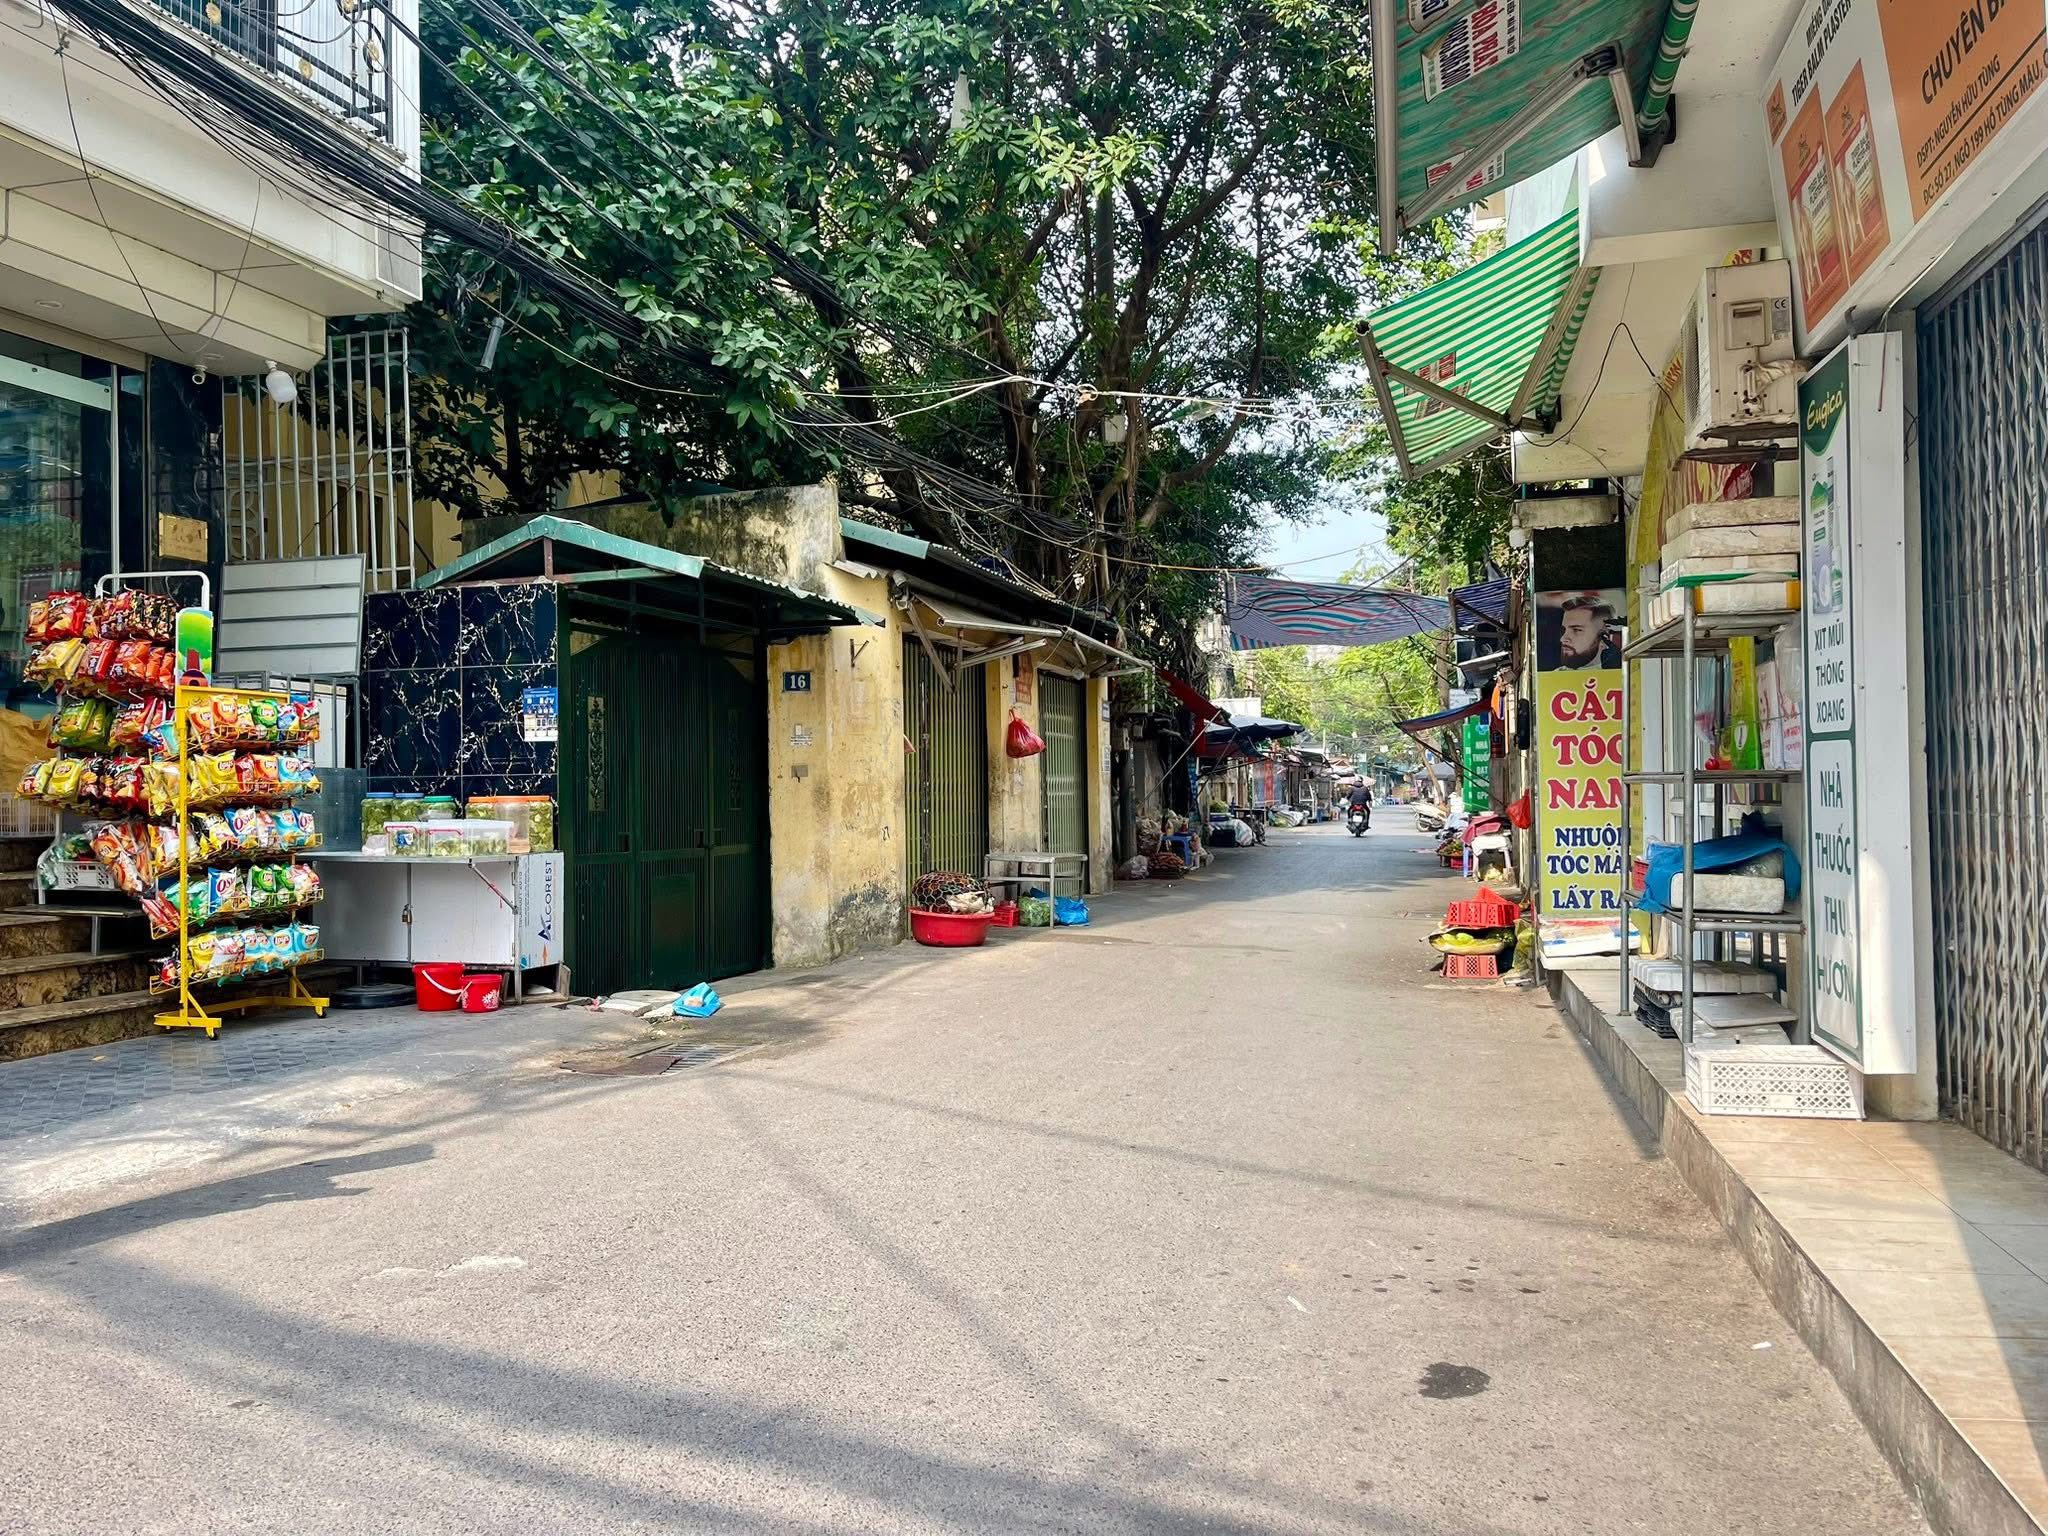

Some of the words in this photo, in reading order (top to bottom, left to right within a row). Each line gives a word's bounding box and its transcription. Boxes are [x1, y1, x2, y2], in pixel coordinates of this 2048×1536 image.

[1471, 1, 1505, 41] HÒA
[1473, 31, 1506, 72] PHÁT
[1792, 67, 1809, 107] TIGER
[1807, 36, 1825, 80] BALM
[1921, 0, 1985, 104] CHUYÊN
[1916, 137, 1936, 168] DSPT:
[1978, 54, 2000, 92] TÙNG
[1970, 125, 1984, 152] 199
[1996, 84, 2019, 122] TÙNG
[1807, 389, 1843, 430] Eugica
[1814, 628, 1827, 656] XỊT
[1828, 618, 1844, 647] MŨI
[790, 674, 806, 689] 16
[1816, 659, 1844, 687] THÔNG
[1816, 698, 1845, 723] XOANG
[1552, 726, 1623, 765] TÓC
[1820, 762, 1843, 808] NHÀ
[1547, 850, 1589, 874] TÓC
[1594, 849, 1628, 874] MÀ
[1815, 824, 1851, 875] THUỐC
[538, 861, 553, 941] ALCOREST
[1552, 885, 1595, 909] LẤY
